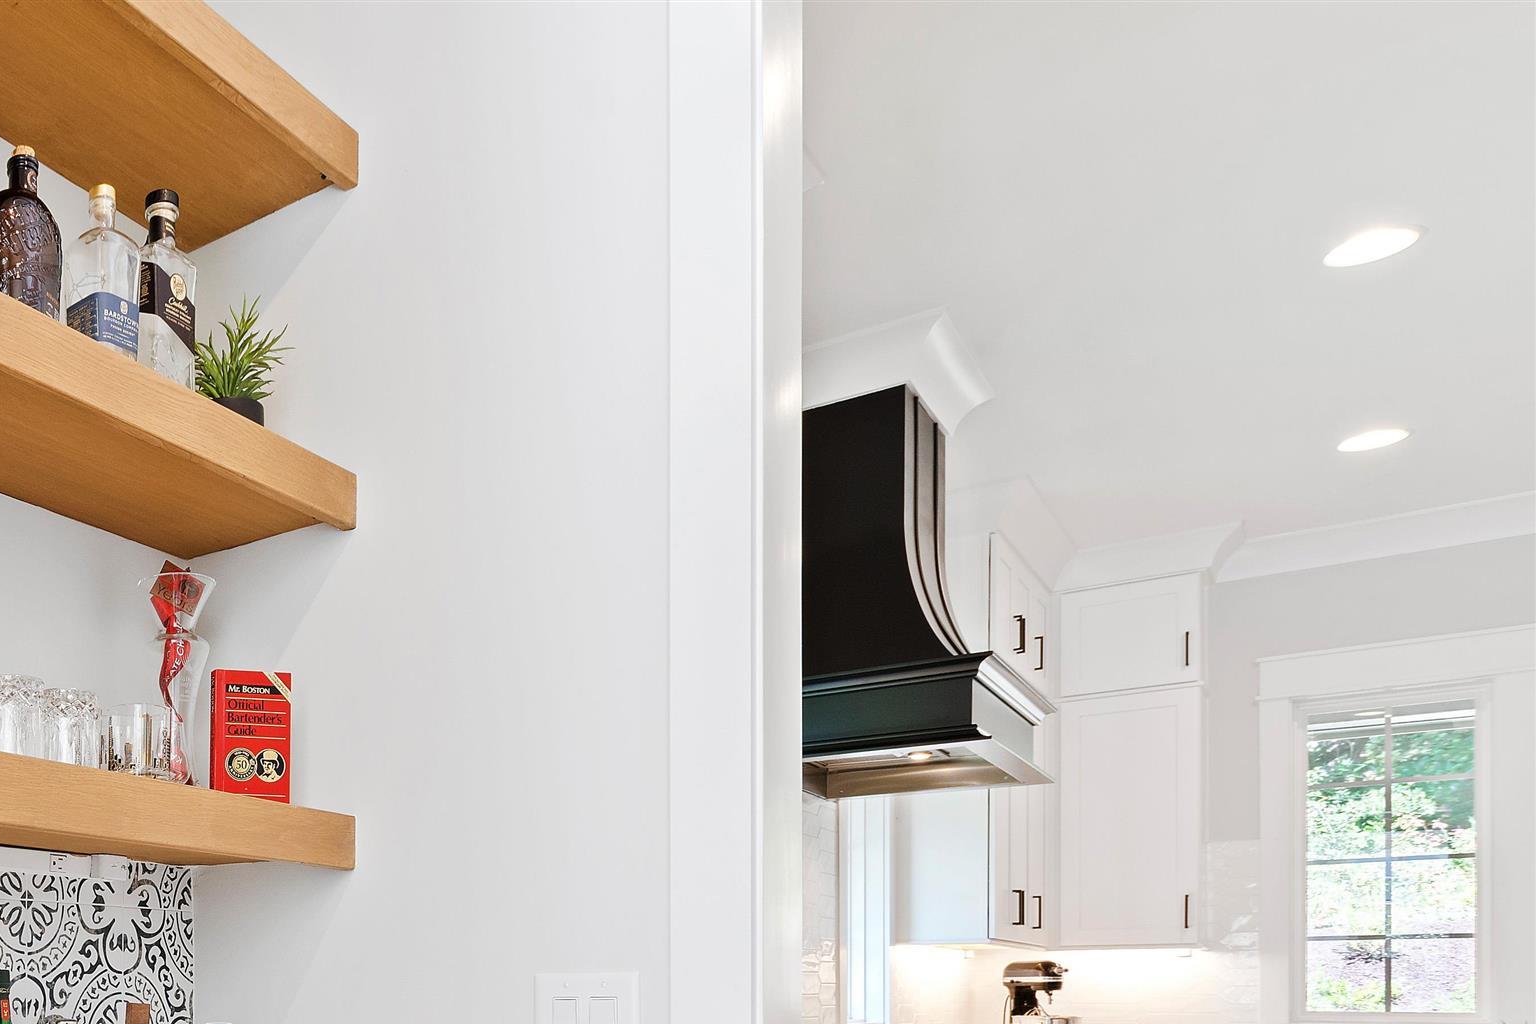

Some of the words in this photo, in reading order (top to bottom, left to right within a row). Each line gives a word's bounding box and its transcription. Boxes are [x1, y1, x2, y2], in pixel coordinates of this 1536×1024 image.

[227, 698, 265, 711] Official
[227, 712, 283, 725] Bartender's
[227, 724, 257, 737] Guide
[236, 760, 248, 770] 50
